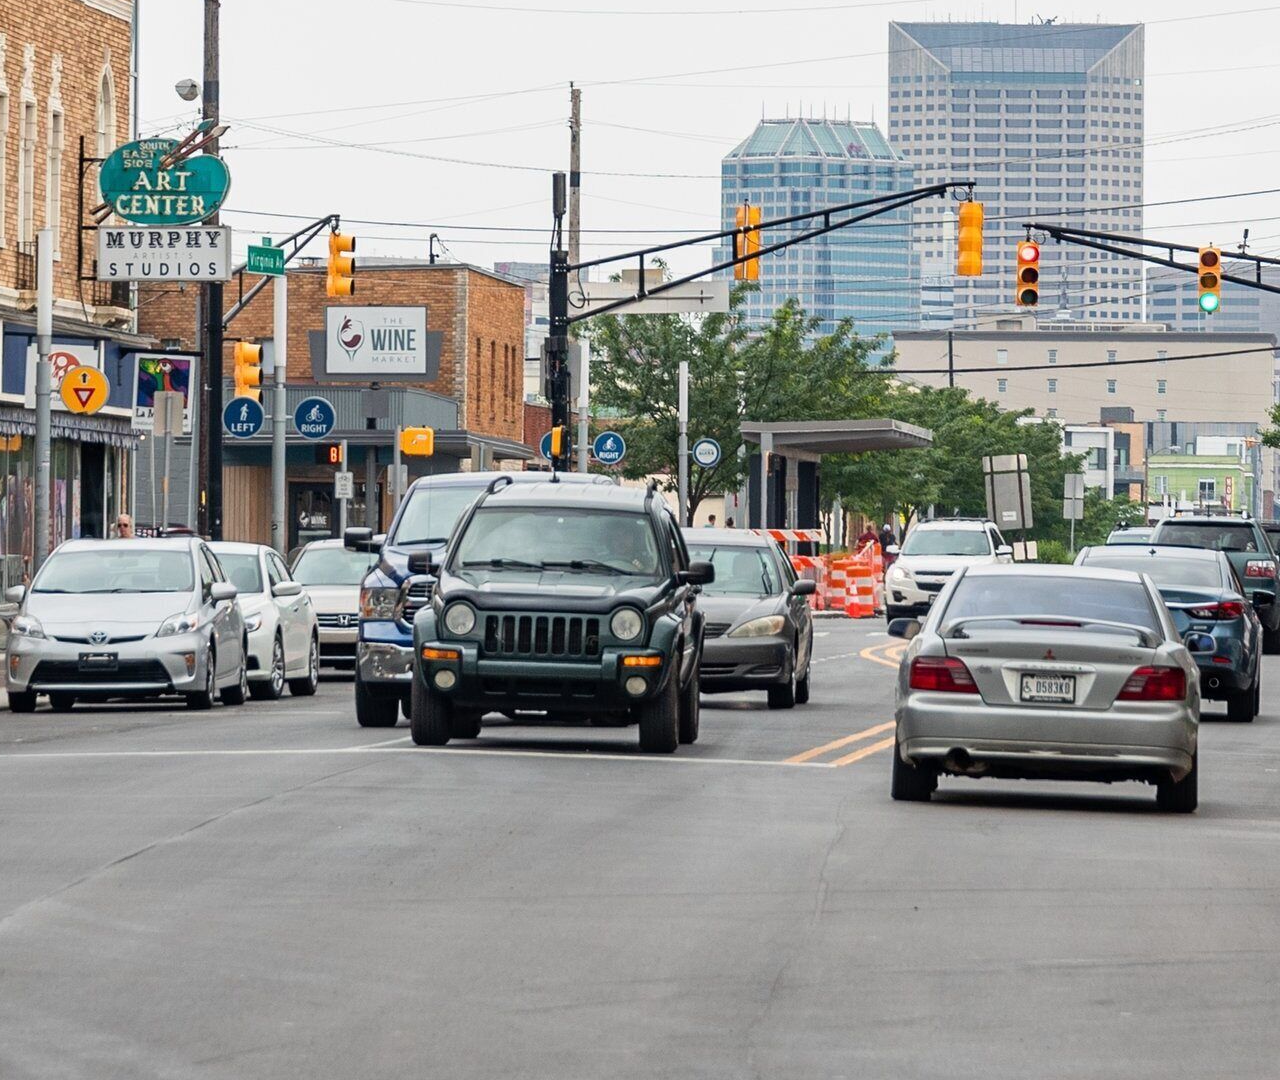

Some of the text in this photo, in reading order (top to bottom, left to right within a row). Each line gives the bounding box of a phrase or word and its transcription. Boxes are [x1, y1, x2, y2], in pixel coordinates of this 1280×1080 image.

[139, 141, 170, 151] SOUTH
[122, 149, 154, 159] EAST
[123, 159, 153, 168] SIDE
[132, 171, 192, 191] ART
[116, 194, 206, 216] CENTER
[106, 231, 221, 249] MURPHY
[133, 252, 193, 260] ARTIST'S
[250, 251, 274, 268] Virginia
[109, 262, 217, 276] STUDIOS
[383, 317, 403, 325] THE
[370, 328, 417, 351] WINE
[231, 423, 255, 433] LEFT
[300, 424, 327, 434] RIGHT
[599, 452, 620, 460] RIGHT
[311, 515, 327, 525] WINE
